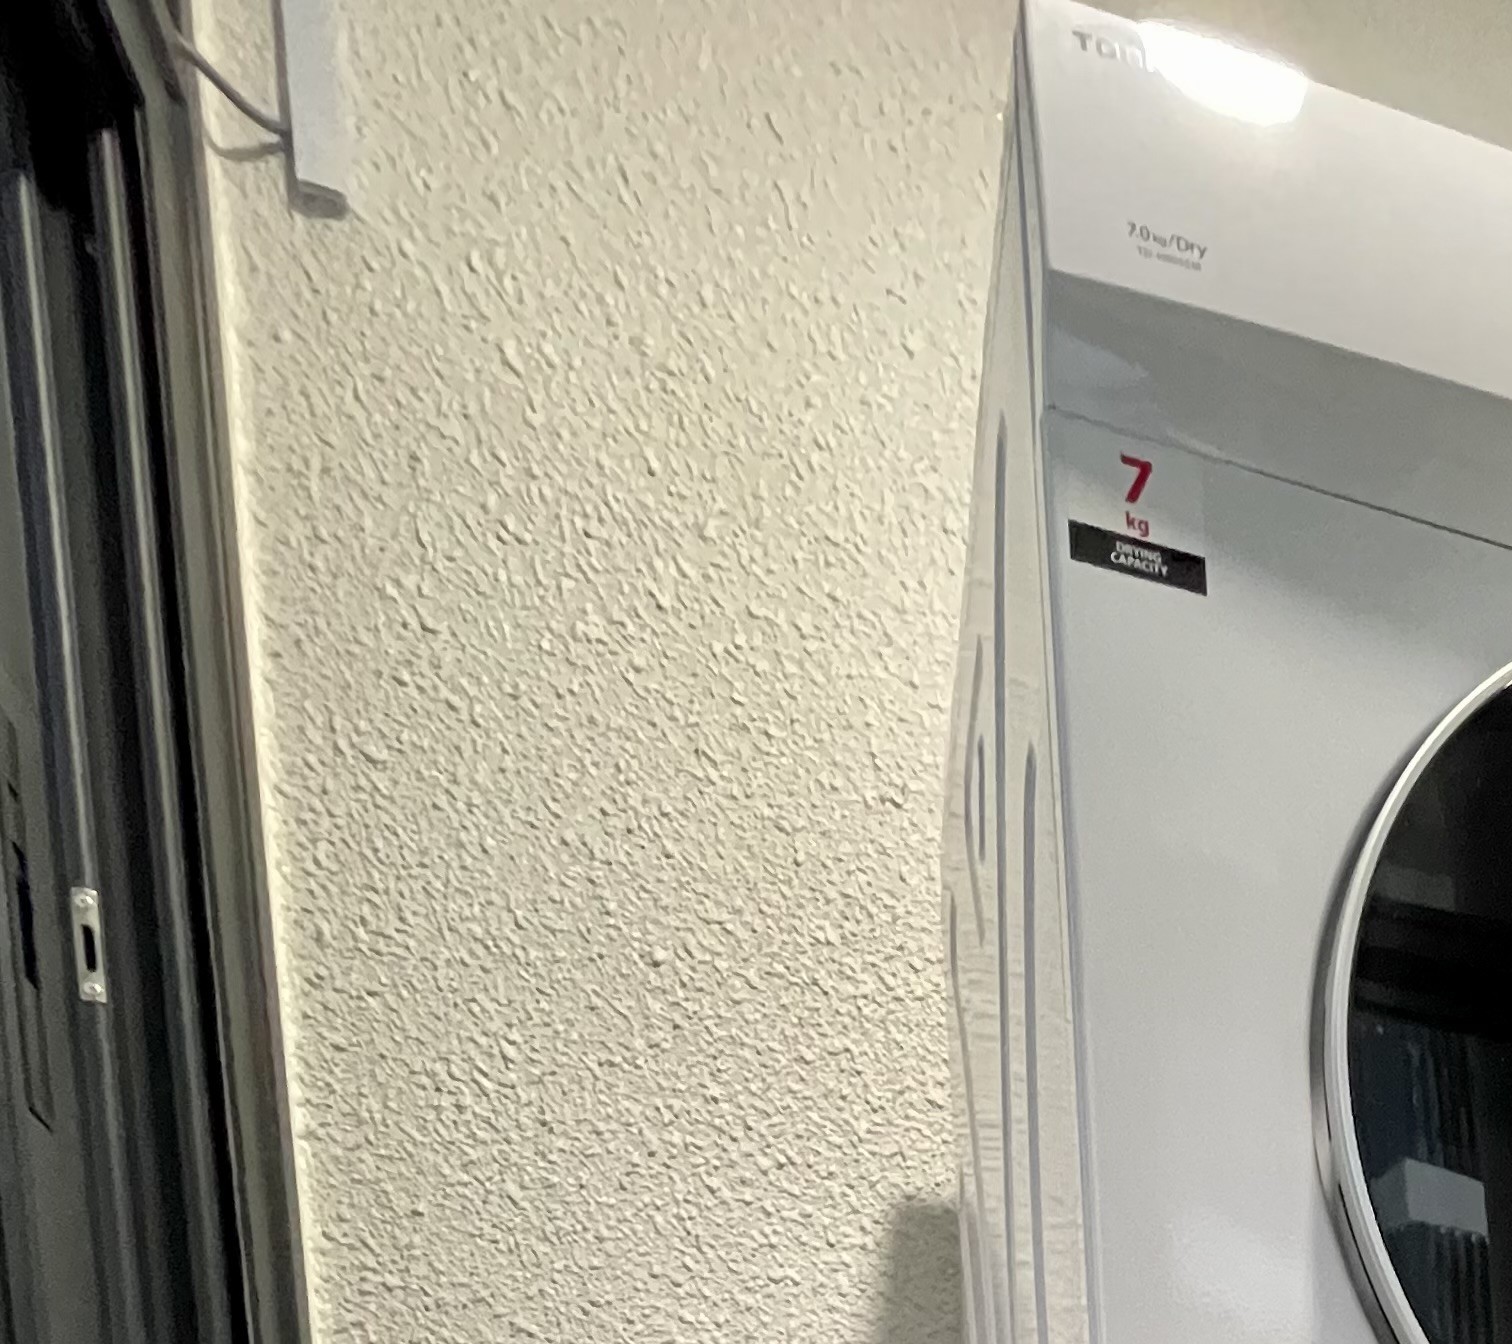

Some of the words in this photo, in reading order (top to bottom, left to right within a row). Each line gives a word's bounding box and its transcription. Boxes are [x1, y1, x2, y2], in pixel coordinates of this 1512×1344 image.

[1120, 452, 1152, 503] 7
[1126, 511, 1150, 538] kg
[1110, 551, 1168, 577] CAPACITY
